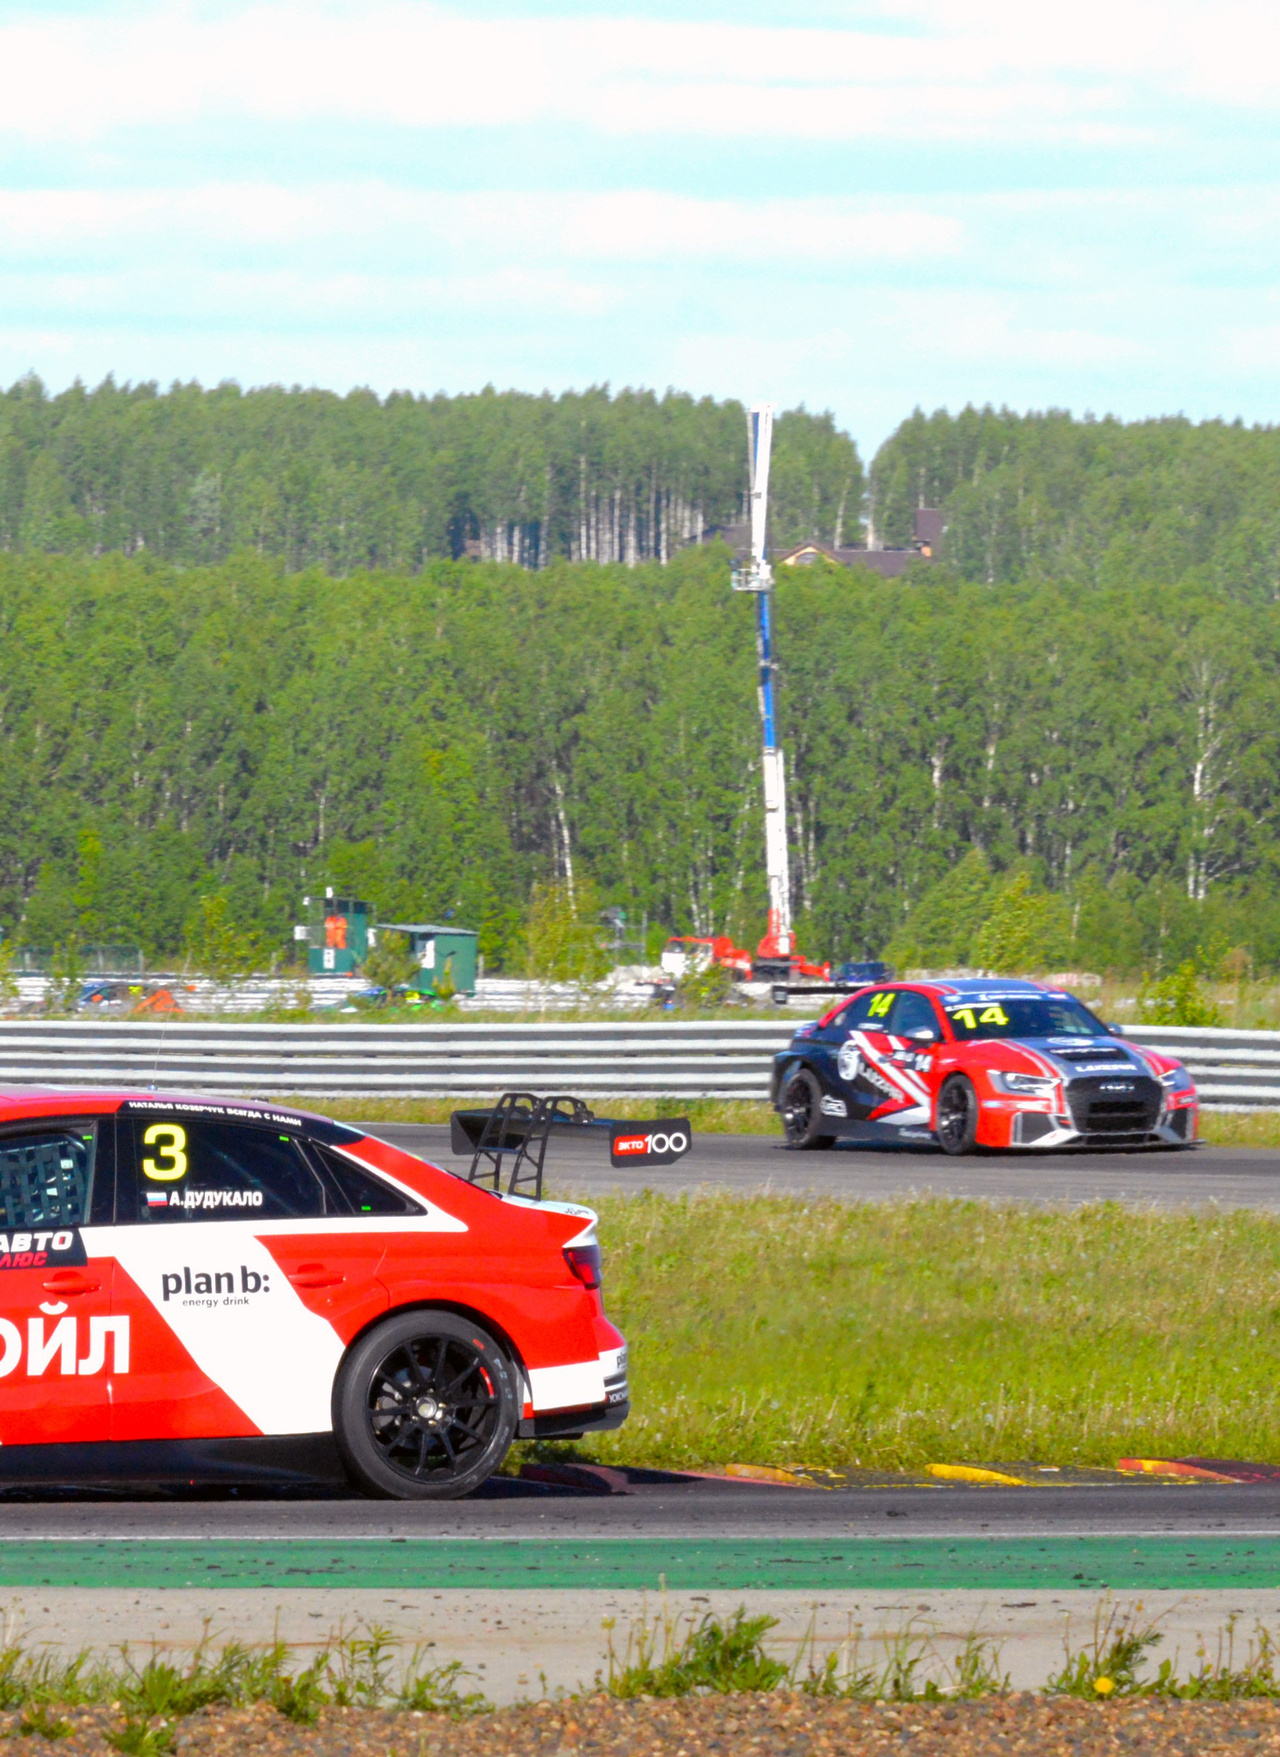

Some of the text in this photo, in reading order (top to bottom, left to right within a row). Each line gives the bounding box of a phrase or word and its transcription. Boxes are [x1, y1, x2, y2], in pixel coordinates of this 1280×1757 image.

[867, 993, 896, 1017] 14
[952, 1007, 1009, 1029] 14
[143, 1124, 187, 1181] 3
[617, 1132, 687, 1154] ЭКТО 100
[169, 1191, 263, 1209] А.ДУДУКАЛО
[162, 1265, 270, 1301] plan b:
[182, 1296, 250, 1308] energy drink
